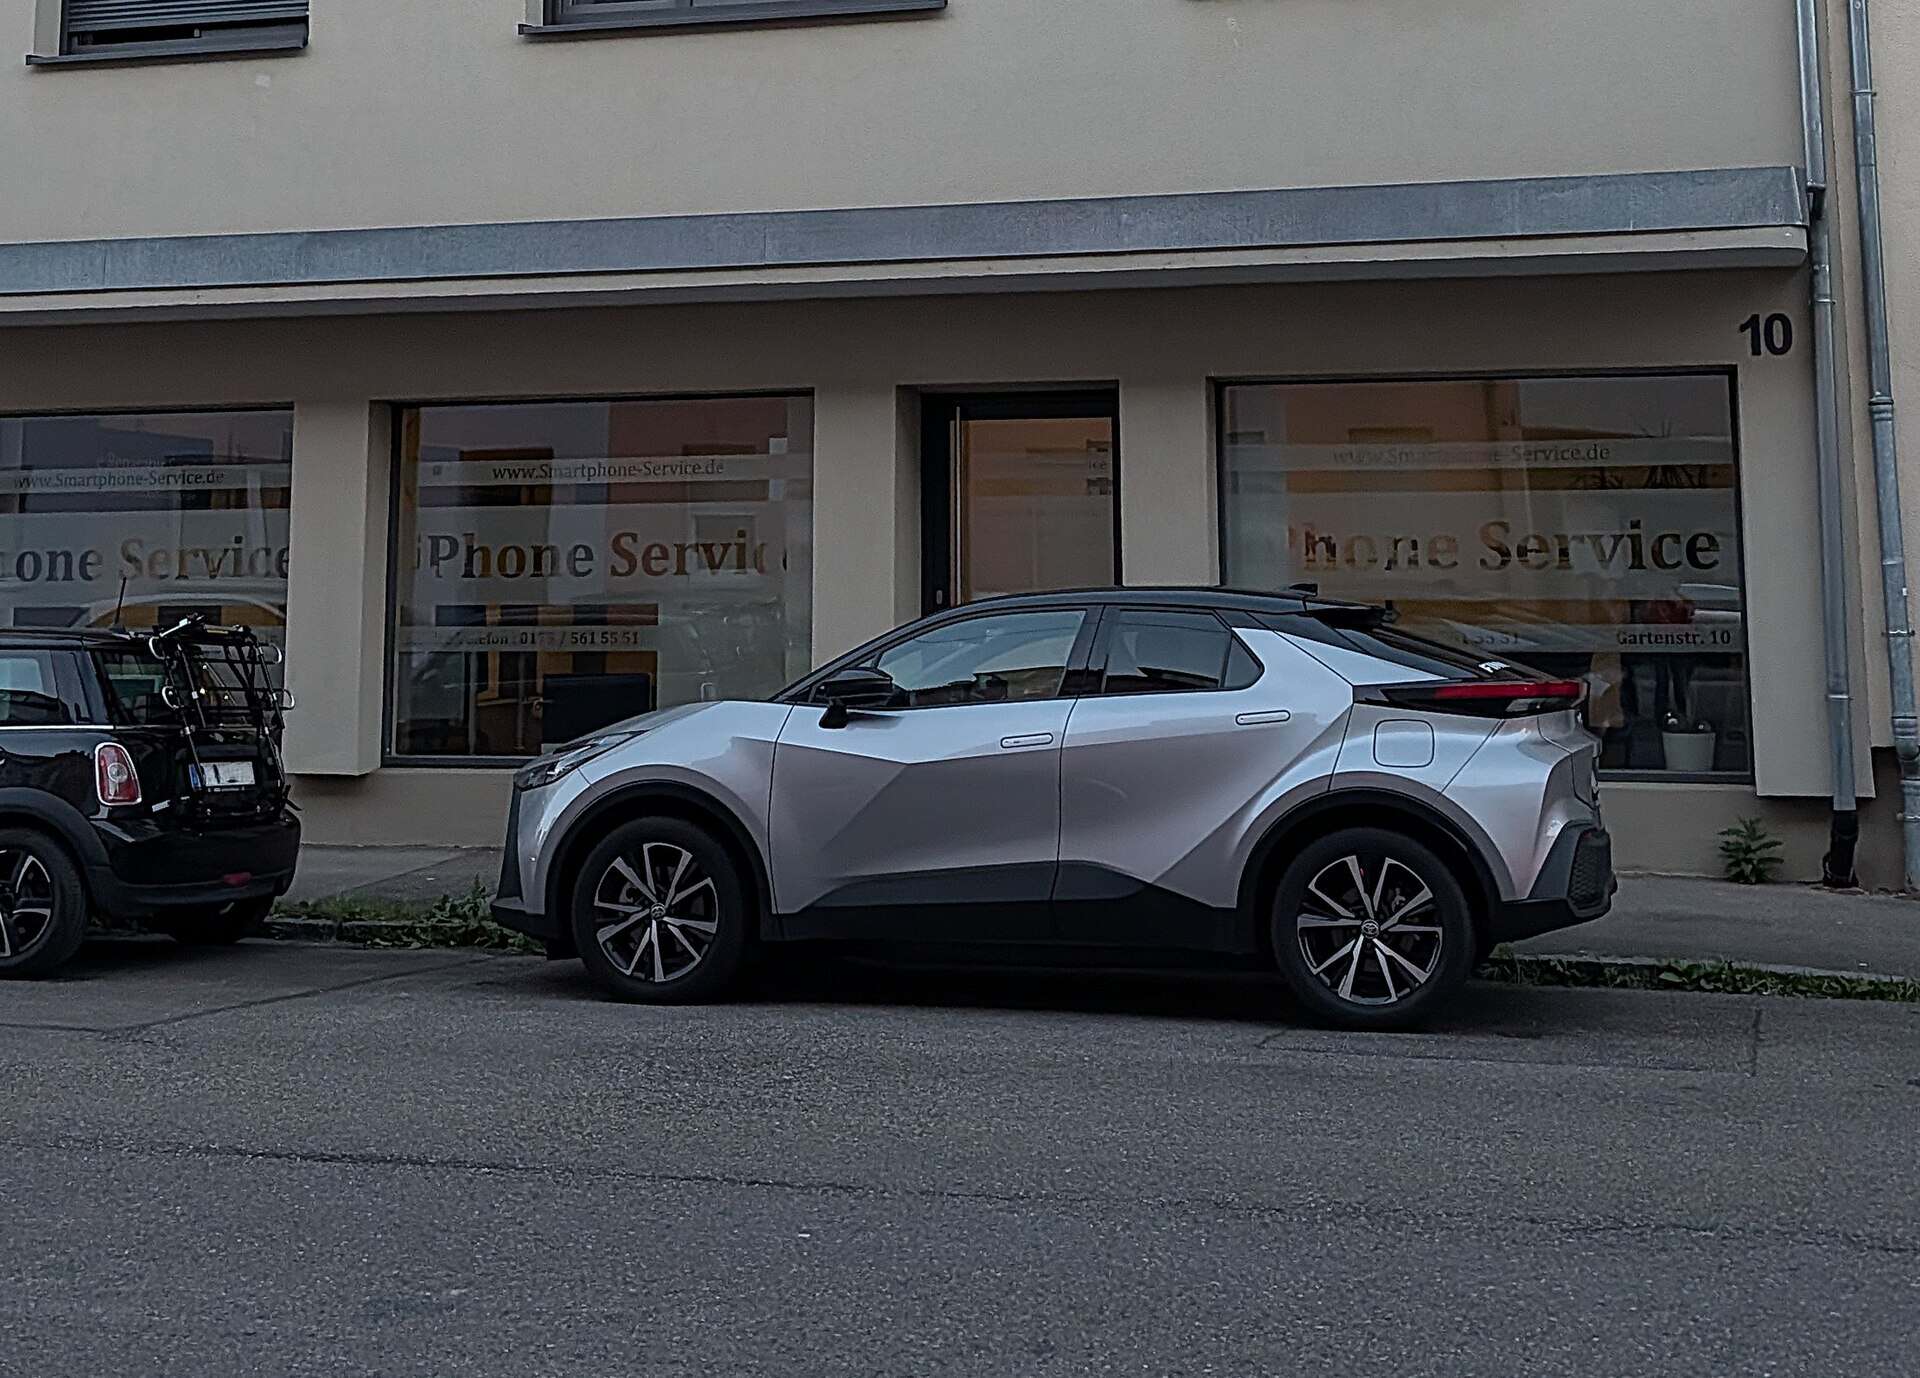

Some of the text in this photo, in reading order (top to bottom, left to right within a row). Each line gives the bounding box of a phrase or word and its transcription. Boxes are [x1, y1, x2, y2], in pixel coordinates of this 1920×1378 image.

[1739, 312, 1793, 356] 10
[1331, 442, 1610, 466] www.Sme-Service.de
[14, 469, 224, 489] www.Smartphone-Service.de
[492, 459, 725, 482] www.Smartphone-Service.de
[1288, 518, 1722, 572] hone Service
[0, 548, 103, 582] one
[1616, 629, 1731, 645] Gartenstr. 10
